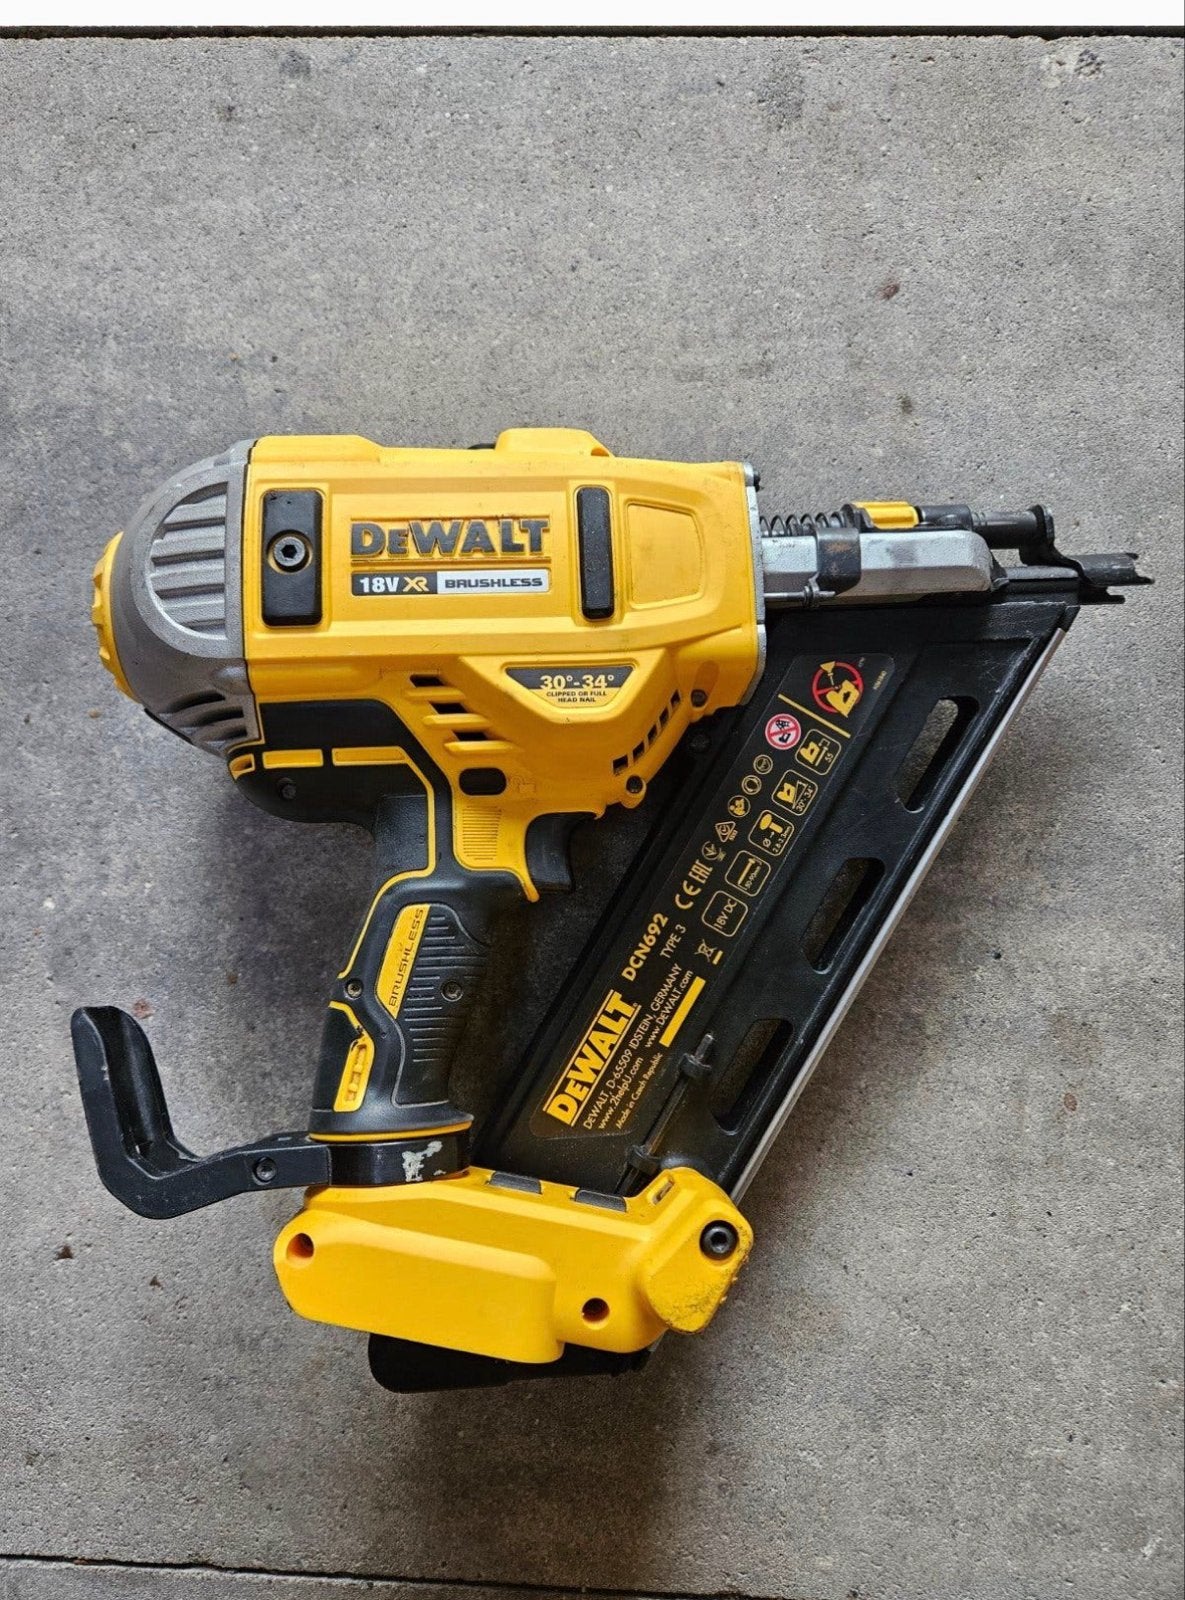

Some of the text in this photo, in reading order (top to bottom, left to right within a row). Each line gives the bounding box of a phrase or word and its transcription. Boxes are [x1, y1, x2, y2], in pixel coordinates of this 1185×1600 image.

[359, 576, 543, 593] 18V XR BRUSHLESS
[620, 910, 669, 982] DCN692
[659, 922, 687, 960] TYPE 3
[713, 897, 737, 930] 18V DC
[389, 908, 424, 1007] BRUSHLESS
[605, 1047, 634, 1089] D-65509
[629, 1011, 656, 1050] IDSTEIN,
[649, 962, 683, 1012] GERMANY
[597, 1055, 644, 1130] www.2helpU.com
[614, 1106, 631, 1128] Made
[629, 1077, 647, 1101] Czech
[642, 1050, 663, 1080] Republic
